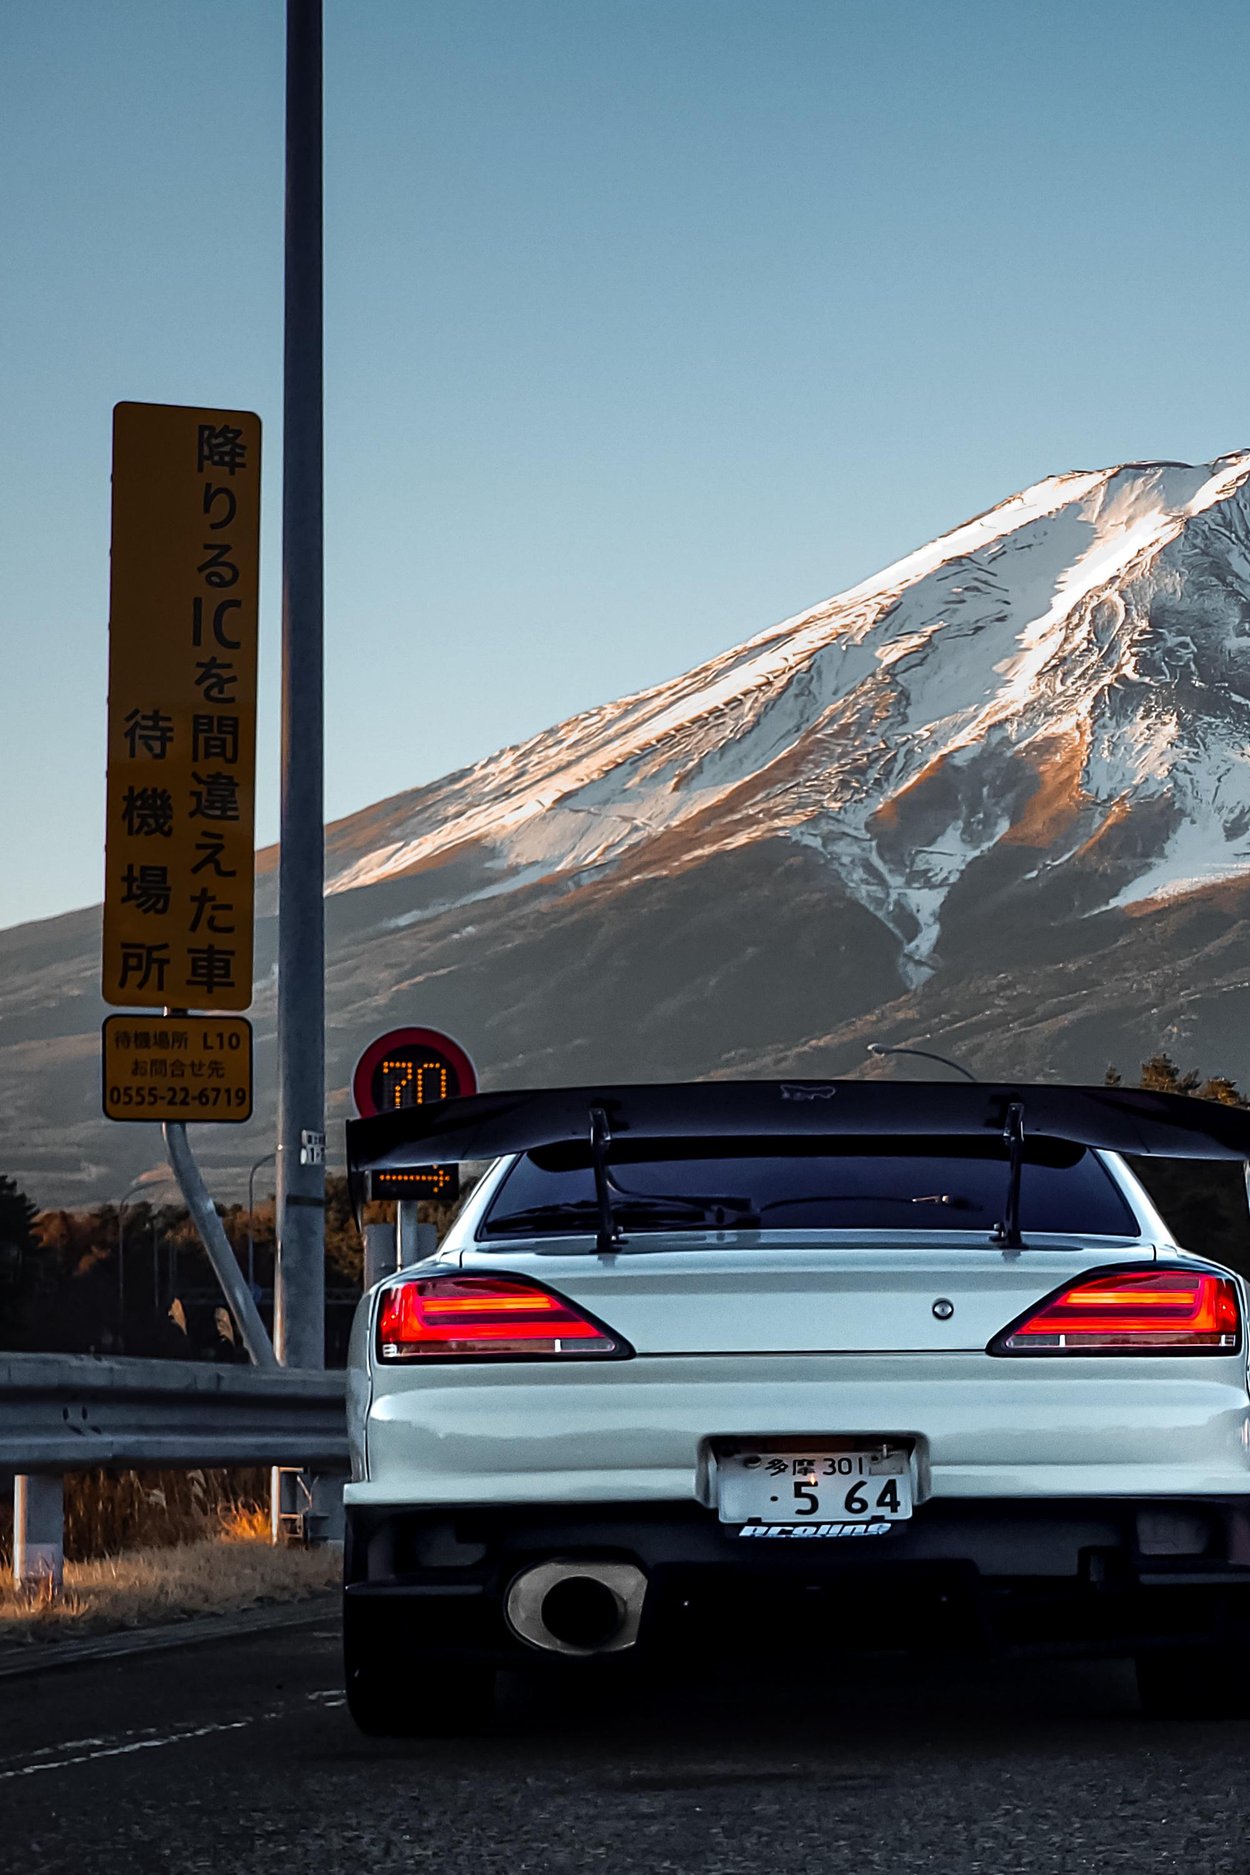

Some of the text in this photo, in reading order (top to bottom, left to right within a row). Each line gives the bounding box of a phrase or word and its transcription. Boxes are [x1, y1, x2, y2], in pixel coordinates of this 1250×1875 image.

[187, 424, 249, 994] 降りるICを間違えた車
[118, 708, 174, 992] 待機場所
[114, 1030, 241, 1051] 待機場所 L10
[130, 1058, 226, 1079] お問合せ先
[382, 1060, 448, 1109] 70
[109, 1085, 247, 1108] 0555-22-6719
[765, 1457, 864, 1477] 多摩 301
